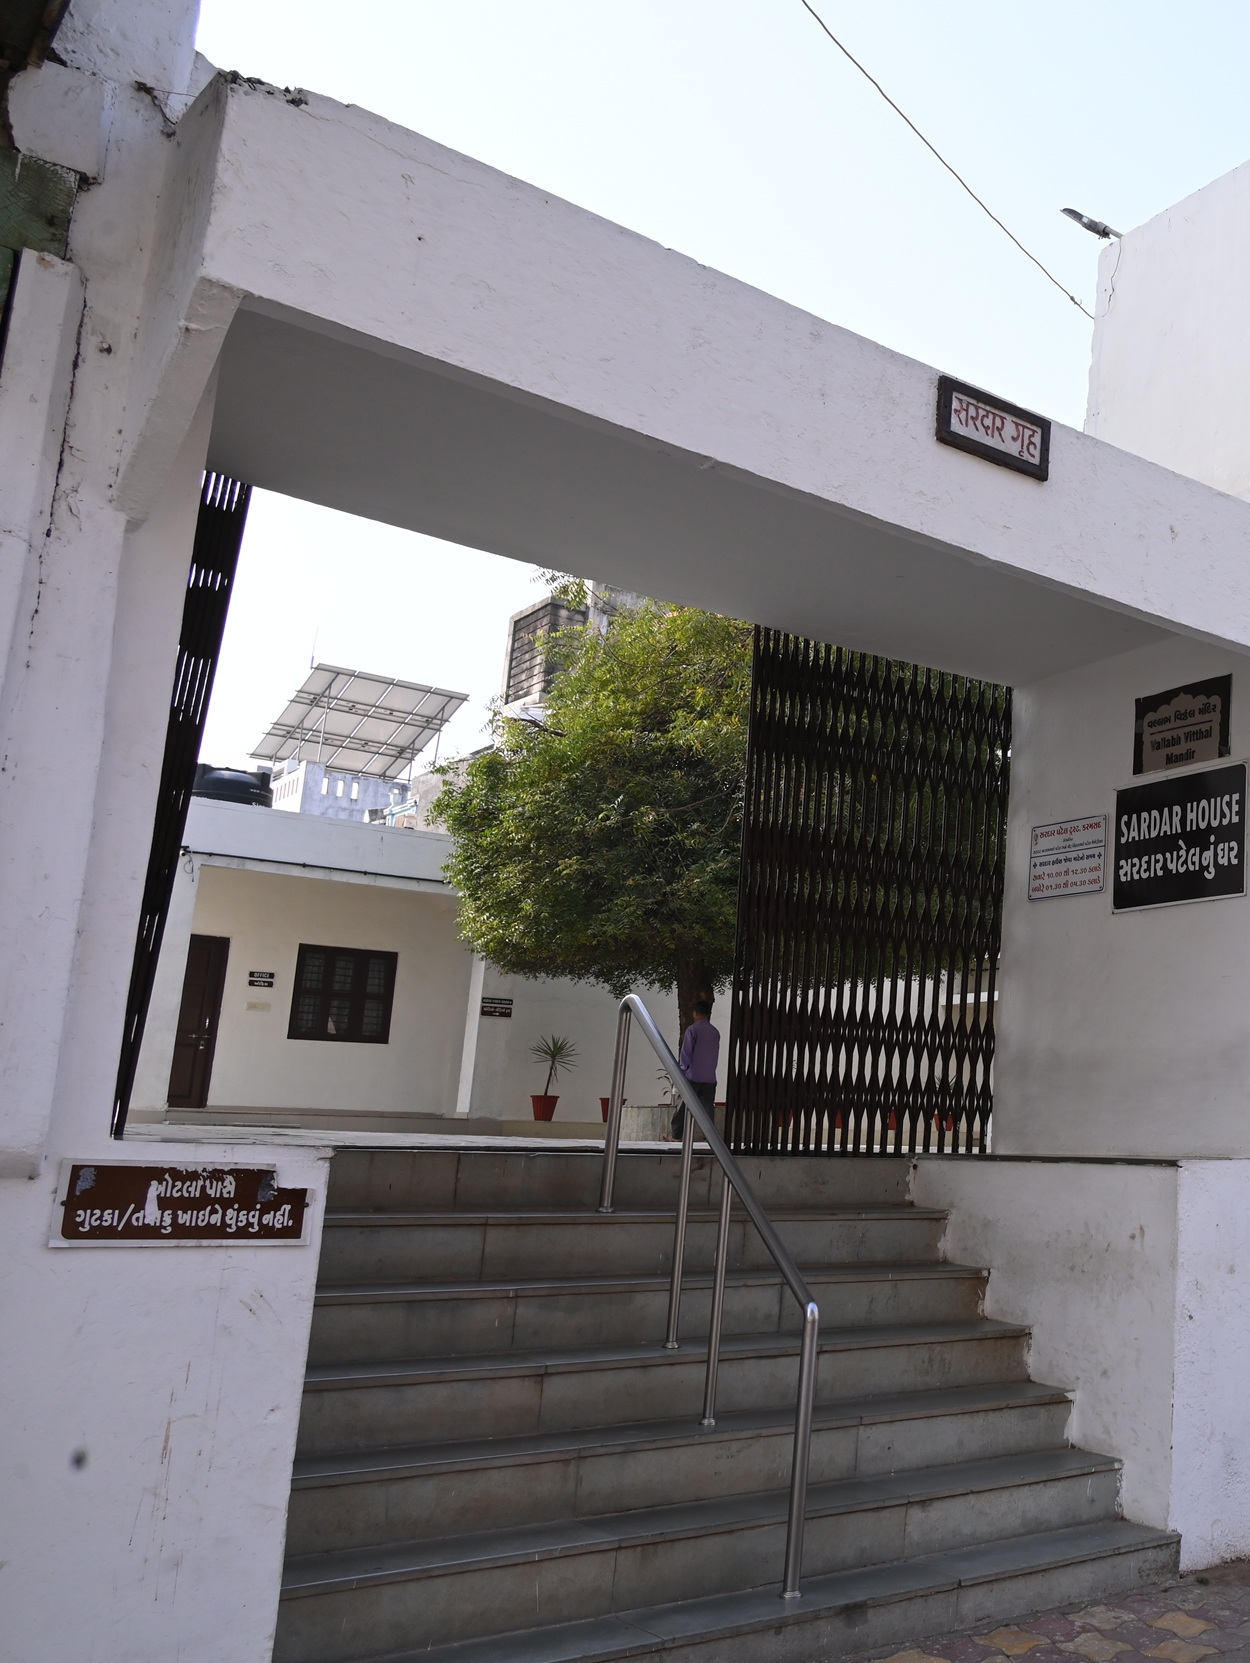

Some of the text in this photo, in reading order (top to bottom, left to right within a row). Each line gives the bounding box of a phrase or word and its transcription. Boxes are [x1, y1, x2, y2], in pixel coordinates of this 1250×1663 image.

[954, 396, 1038, 458] सरदार गृह
[1198, 702, 1217, 715] મંદિર
[1150, 726, 1213, 752] Vallabh Vitthal
[1165, 748, 1196, 765] Mandir
[1120, 793, 1240, 844] SARDAR HOUSE
[1119, 853, 1164, 882] સરદાર
[1217, 841, 1239, 866] ઘર
